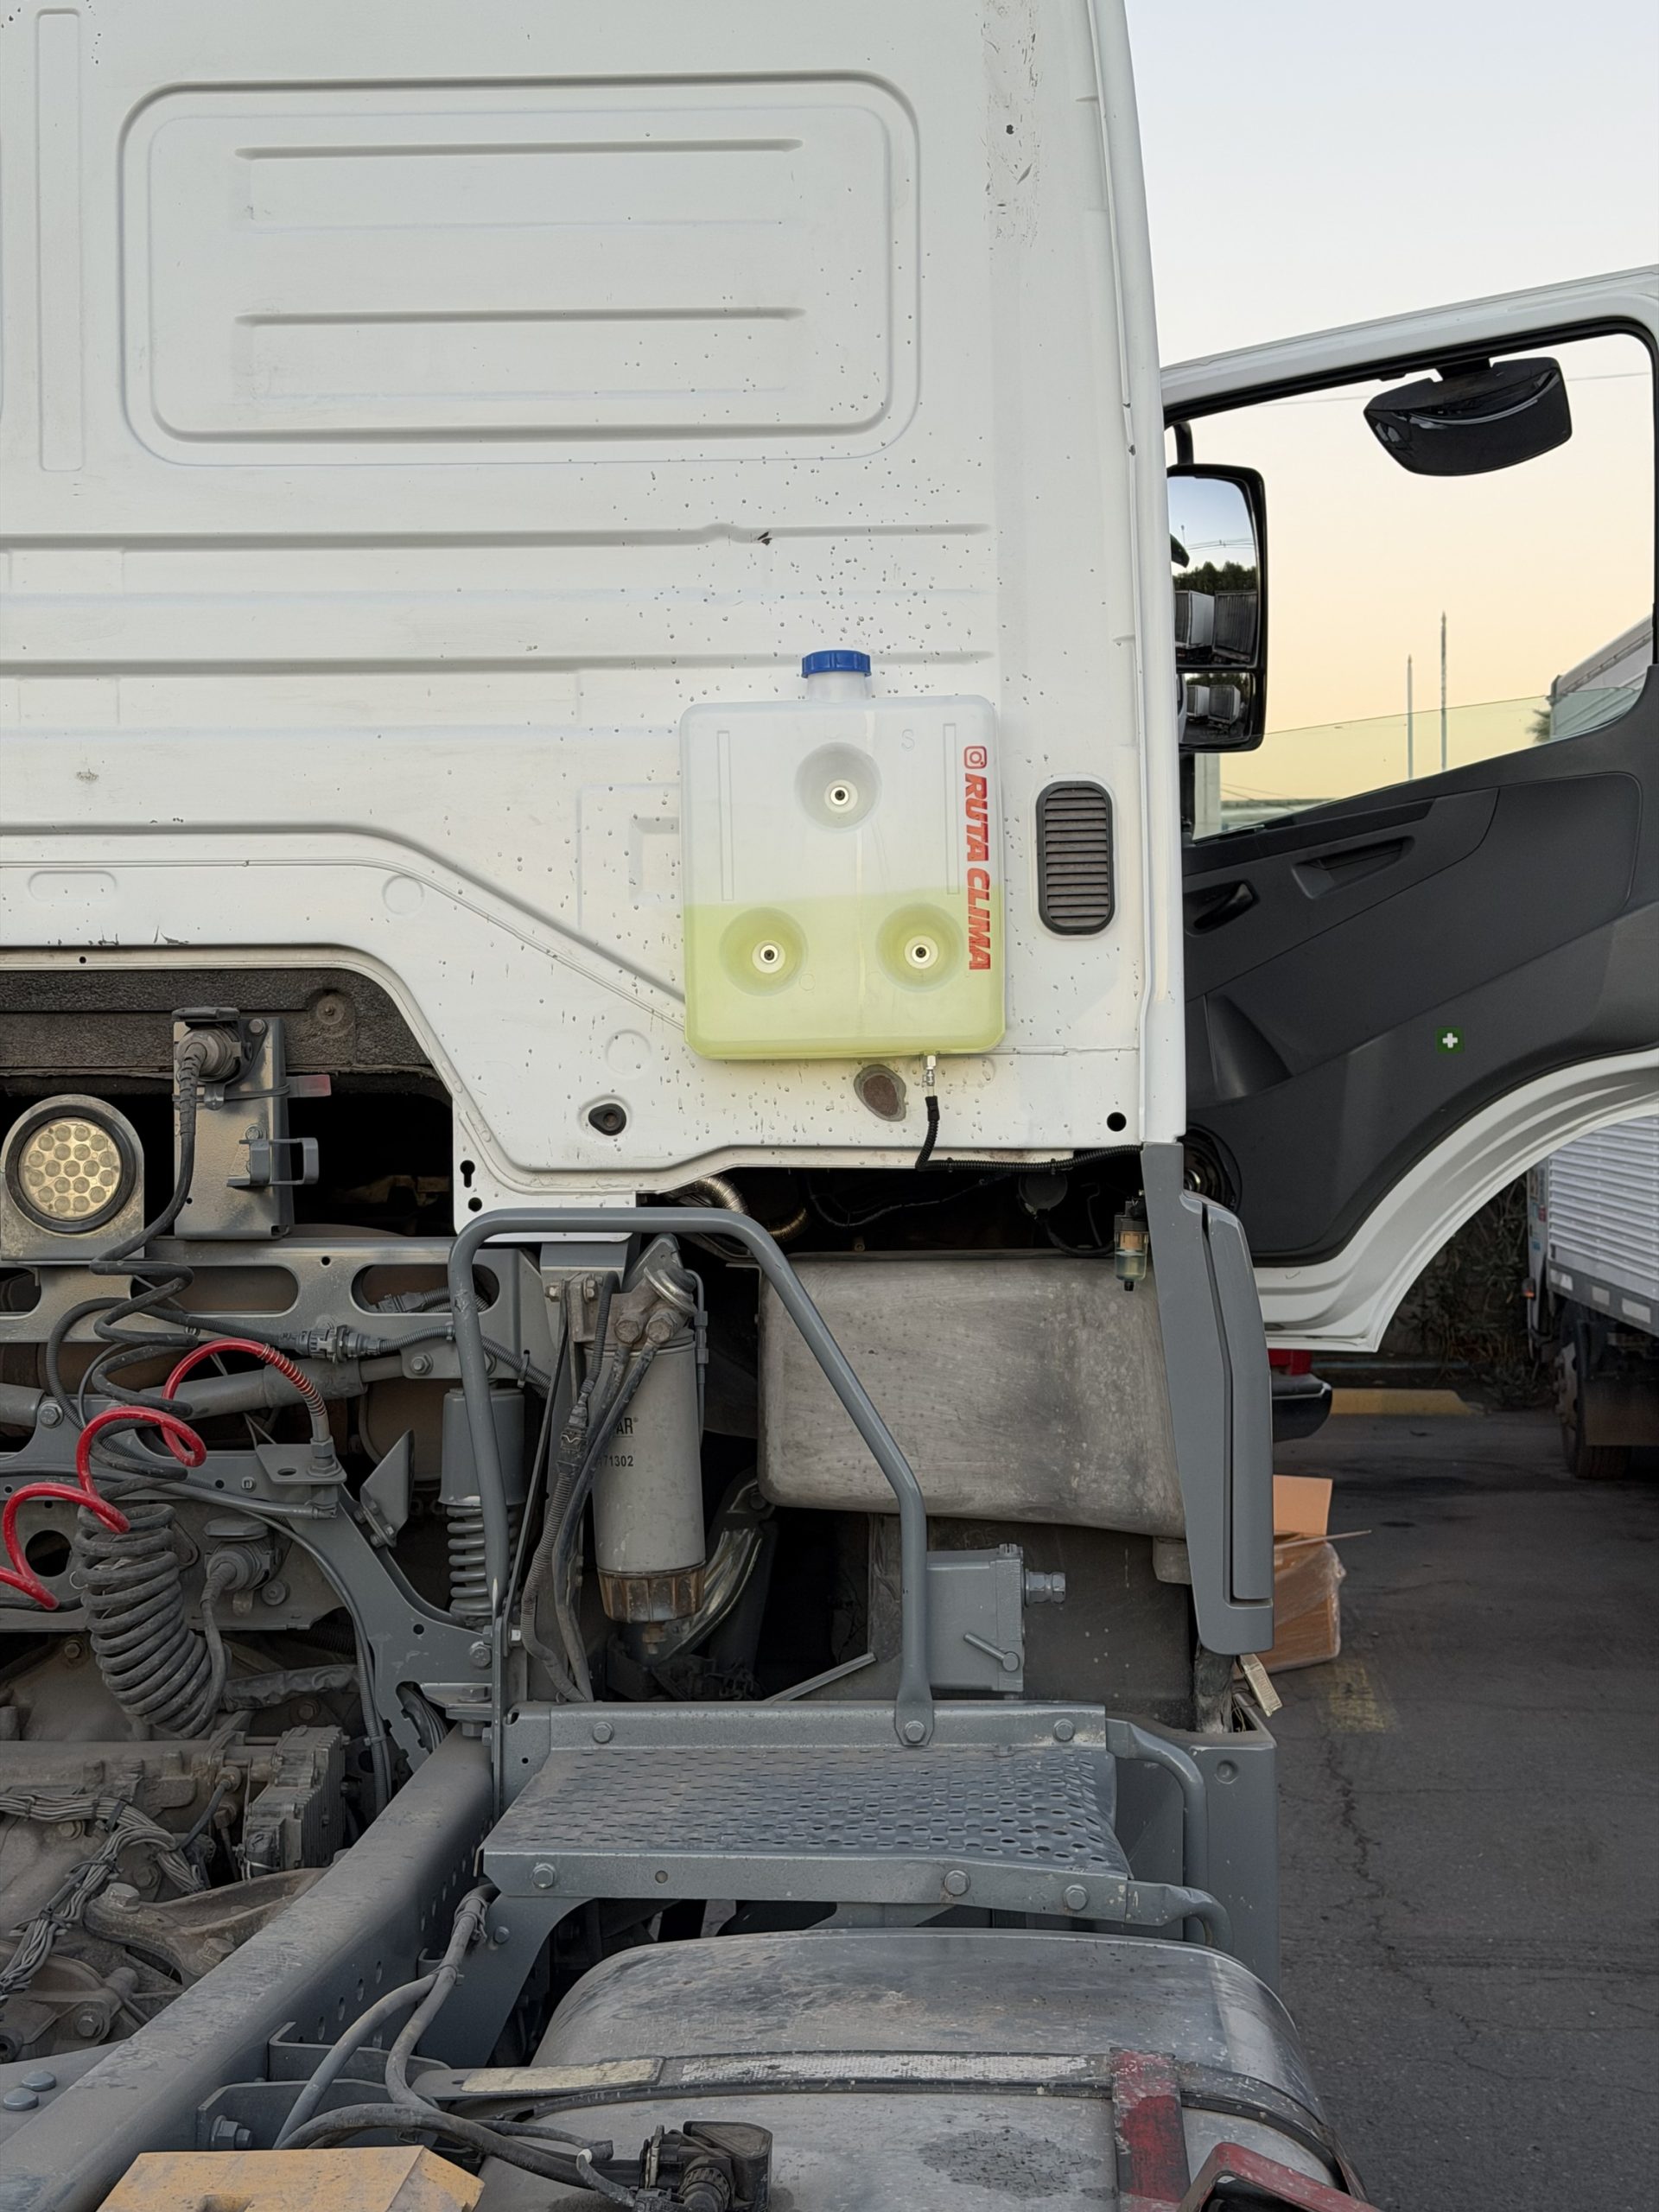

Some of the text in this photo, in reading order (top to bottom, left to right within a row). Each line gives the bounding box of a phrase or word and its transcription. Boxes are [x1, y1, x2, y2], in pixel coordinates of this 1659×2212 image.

[965, 773, 991, 970] RUTA CLIMA
[616, 1417, 634, 1435] AR
[599, 1455, 634, 1467] 71302
